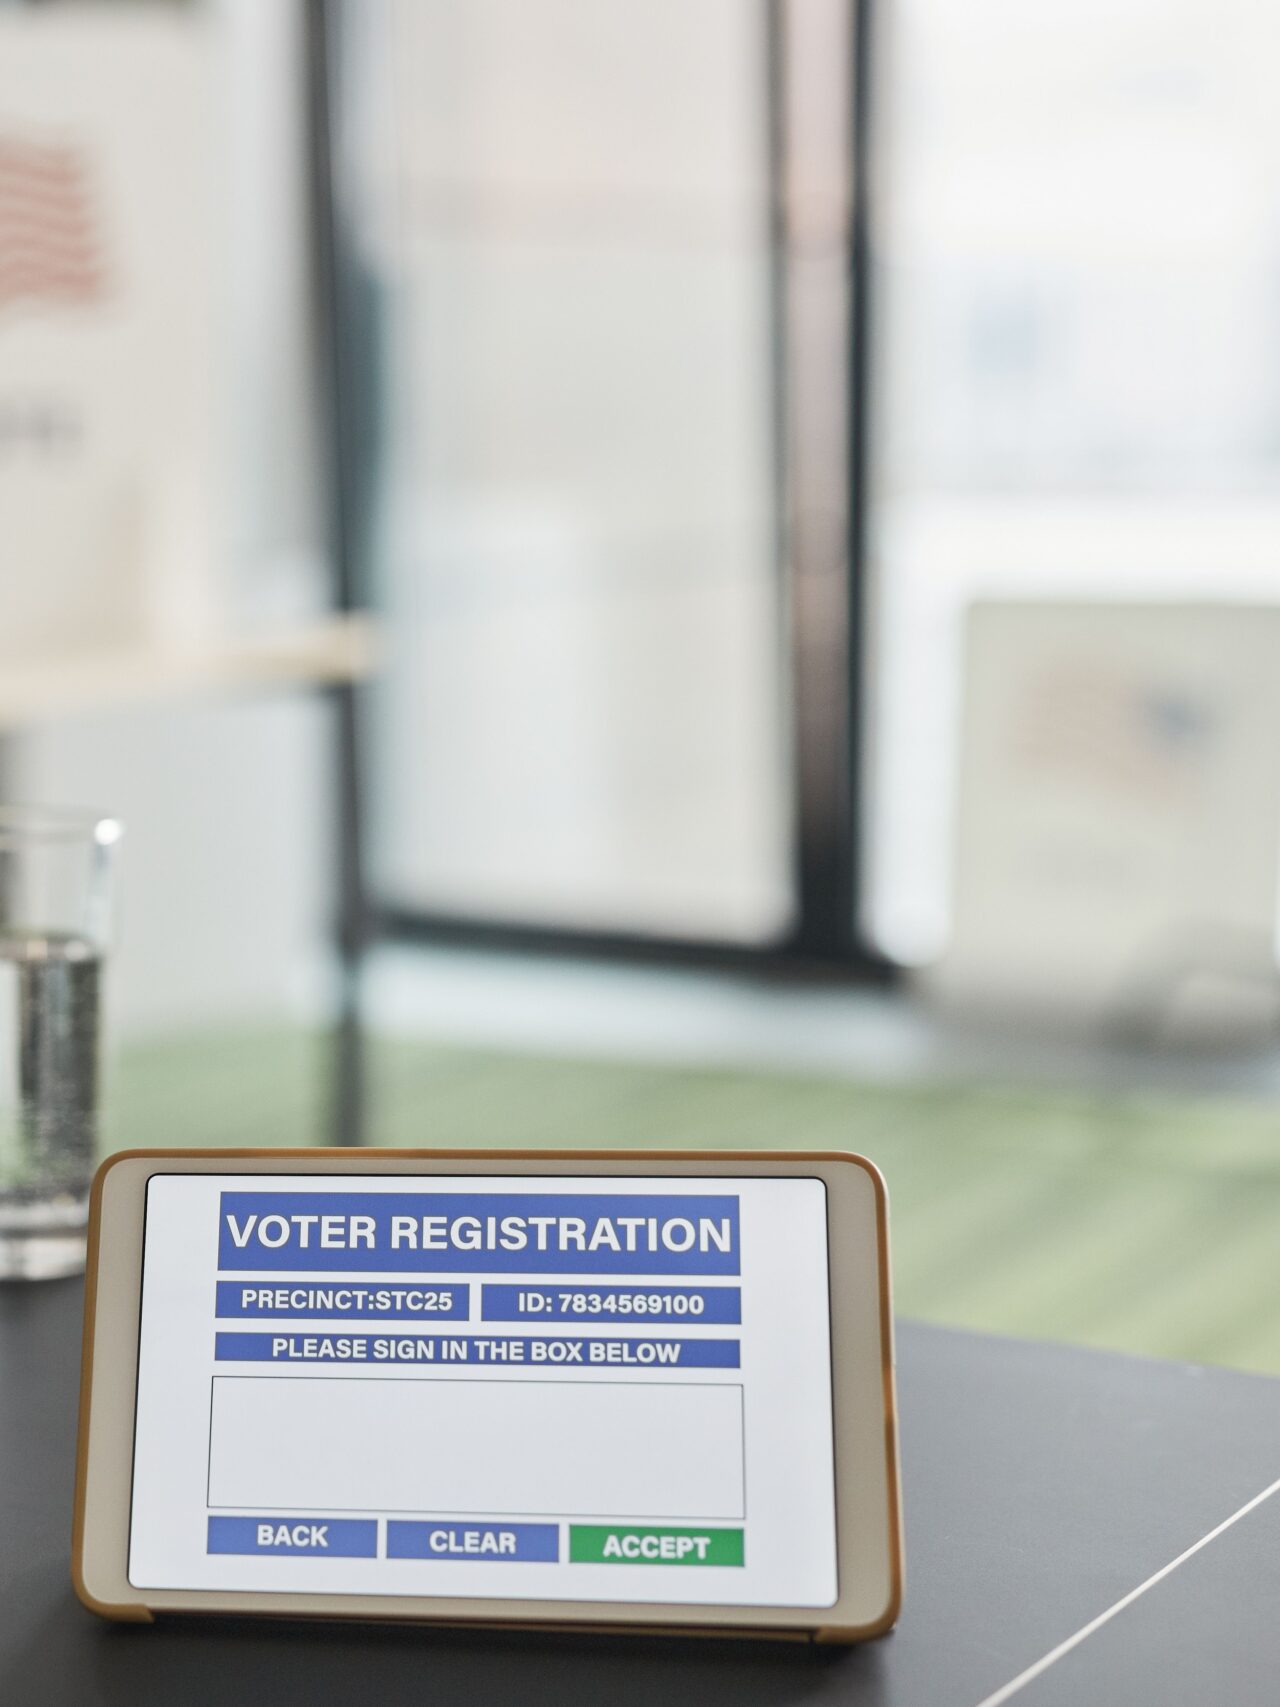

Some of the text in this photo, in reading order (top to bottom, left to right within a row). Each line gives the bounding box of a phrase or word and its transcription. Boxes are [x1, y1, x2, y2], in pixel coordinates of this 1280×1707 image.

[226, 1214, 732, 1253] VOTER REGISTRATION
[518, 1293, 705, 1315] ID: 7834569100
[272, 1338, 681, 1364] PLEASE SIGN IN THE BOX BELOW
[257, 1524, 328, 1548] BACK
[429, 1530, 516, 1554] CLEAR
[602, 1534, 711, 1560] ACCEPT
